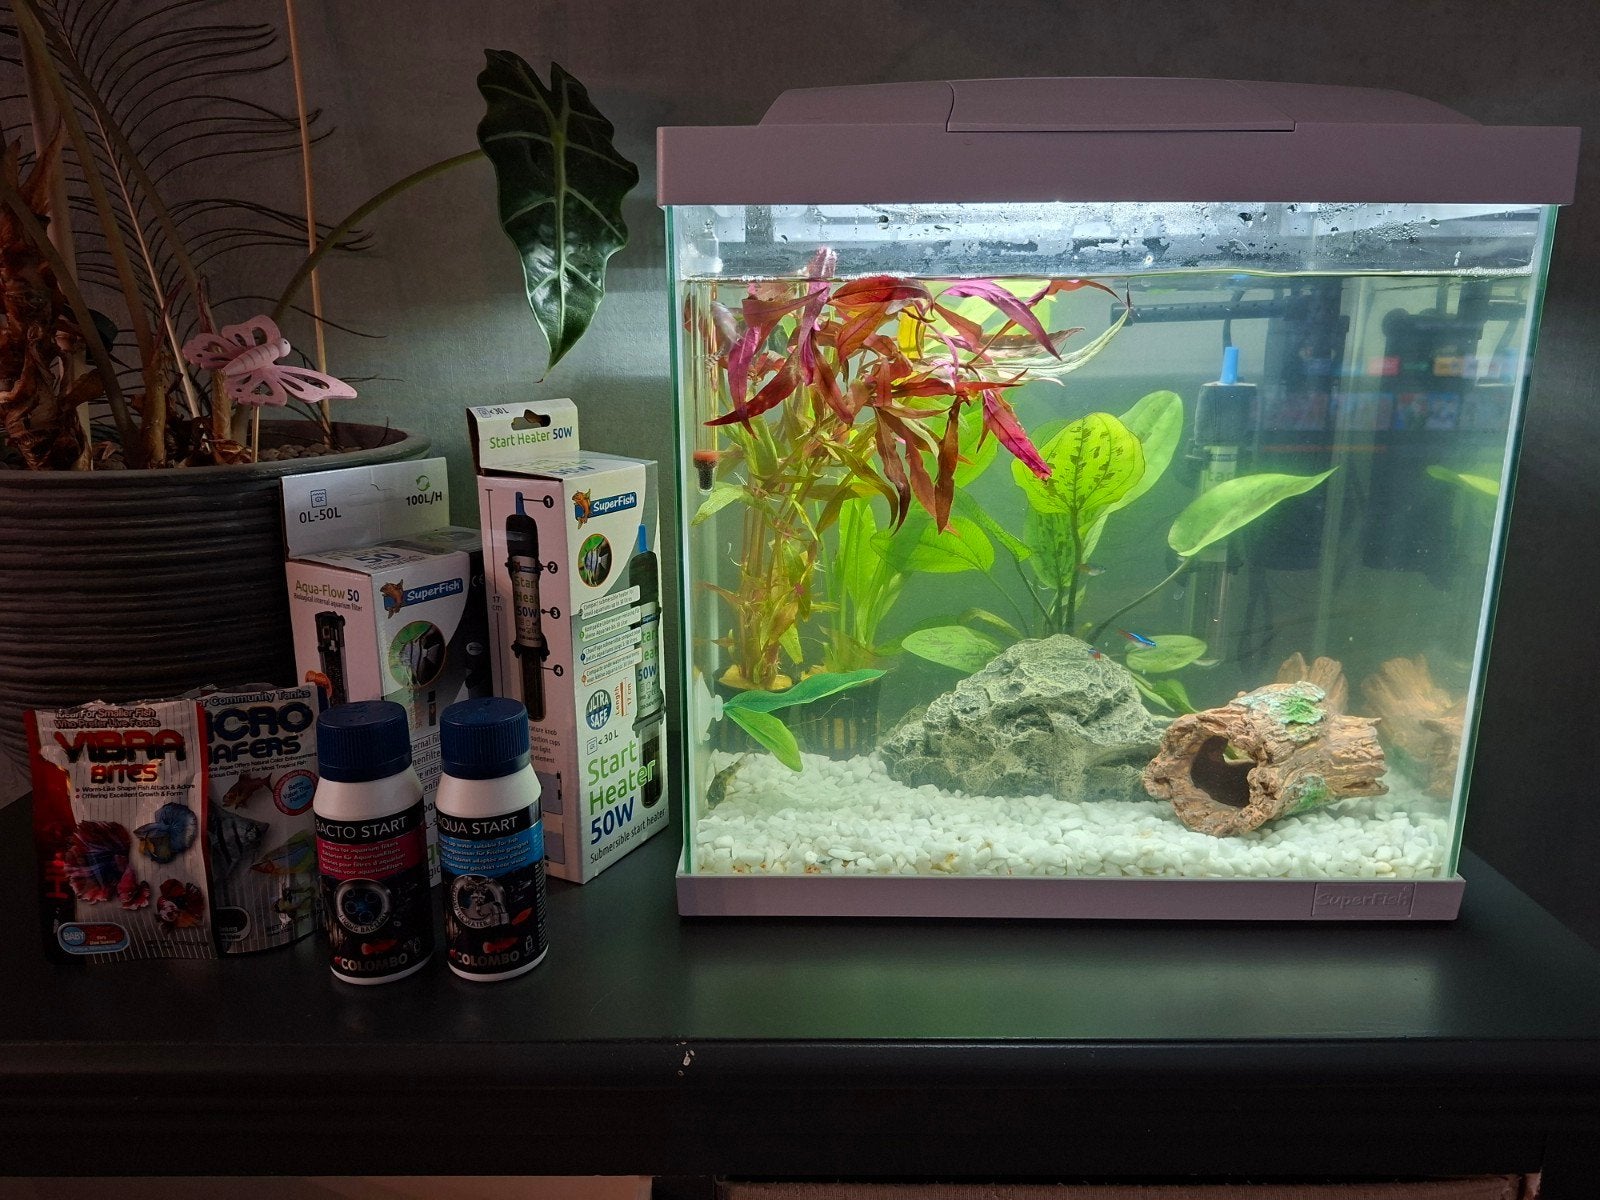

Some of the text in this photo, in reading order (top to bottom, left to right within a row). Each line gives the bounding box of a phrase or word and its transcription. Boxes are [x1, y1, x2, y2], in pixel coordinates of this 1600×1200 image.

[490, 426, 572, 449] Start Heater 50W
[406, 492, 442, 506] 100L/H
[593, 495, 635, 512] SuperFish
[296, 580, 360, 602] Aqua-Flow 50
[407, 582, 460, 601] SuperFish
[638, 663, 656, 681] 50W
[210, 692, 276, 706] Community
[276, 689, 310, 700] Tanks
[589, 692, 609, 712] ULTRA
[98, 708, 134, 718] Smaller
[134, 708, 156, 718] Fish
[590, 708, 608, 728] SAFE
[208, 702, 313, 744] ICRO
[54, 729, 186, 764] VIBRA
[414, 738, 431, 750] ernal
[412, 751, 440, 766] nenfilte
[588, 740, 637, 786] Start
[91, 764, 158, 784] BITES
[425, 764, 442, 776] inter
[424, 777, 440, 791] enfil
[590, 760, 655, 816] Heater
[316, 819, 356, 838] BACTO
[361, 816, 407, 838] START
[438, 814, 468, 834] AQUA
[472, 816, 517, 835] START
[591, 796, 634, 846] 50W
[590, 808, 665, 864] Submersible start heater
[1316, 892, 1408, 909] SuperFish
[341, 953, 408, 972] COLOMBO
[457, 950, 520, 967] COLOMBO
